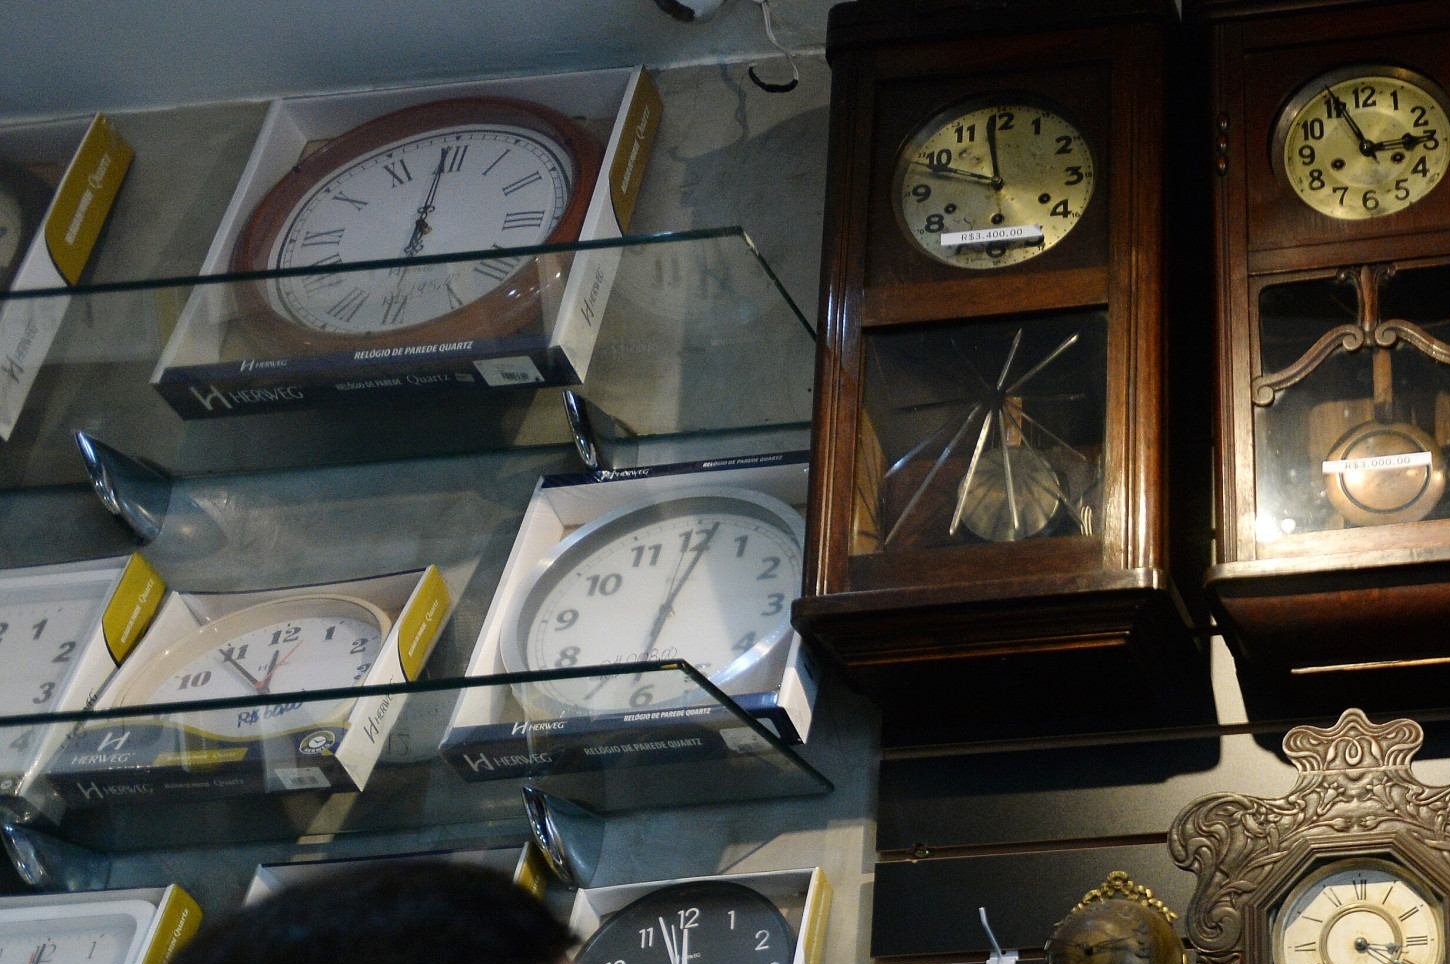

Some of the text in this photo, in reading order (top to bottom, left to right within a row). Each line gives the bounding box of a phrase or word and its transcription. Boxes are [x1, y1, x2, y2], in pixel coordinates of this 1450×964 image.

[1353, 86, 1376, 108] 12
[1391, 91, 1398, 110] 1
[1411, 107, 1428, 126] 2
[955, 124, 976, 143] 11
[1032, 118, 1041, 135] 1
[1302, 118, 1324, 140] 10
[1055, 136, 1073, 155] 2
[928, 149, 952, 169] 10
[1299, 146, 1315, 165] 9
[1065, 166, 1083, 185] 3
[1412, 157, 1429, 177] 4
[1309, 169, 1324, 190] 8
[912, 184, 931, 203] 9
[1333, 187, 1348, 206] 7
[1395, 180, 1409, 200] 5
[1051, 200, 1070, 218] 4
[1363, 191, 1378, 210] 6
[925, 214, 944, 233] 8
[392, 348, 403, 356] DE
[404, 344, 437, 355] PAREDE
[439, 341, 474, 351] QUARTZ
[229, 386, 303, 403] HERWEG
[631, 544, 663, 568] 11
[734, 535, 748, 558] 1
[756, 557, 781, 580] 2
[586, 573, 622, 596] 10
[762, 593, 784, 616] 3
[32, 618, 48, 640] 1
[554, 609, 579, 631] 9
[269, 627, 301, 646] 12
[325, 626, 336, 640] 1
[52, 641, 76, 662] 2
[351, 638, 368, 654] 2
[554, 646, 581, 668] 8
[179, 671, 211, 689] 10
[33, 682, 55, 704] 3
[624, 708, 711, 721] RELÓGIO DE PAREDE QUARTZ
[529, 722, 564, 731] HERWEG
[622, 743, 632, 753] DE
[634, 740, 667, 752] PAREDE
[668, 737, 702, 748] QUARTZ
[72, 753, 128, 764] HERWEG
[677, 908, 700, 929] 12
[728, 910, 736, 930] 1
[639, 927, 654, 949] 11
[755, 930, 769, 950] 2
